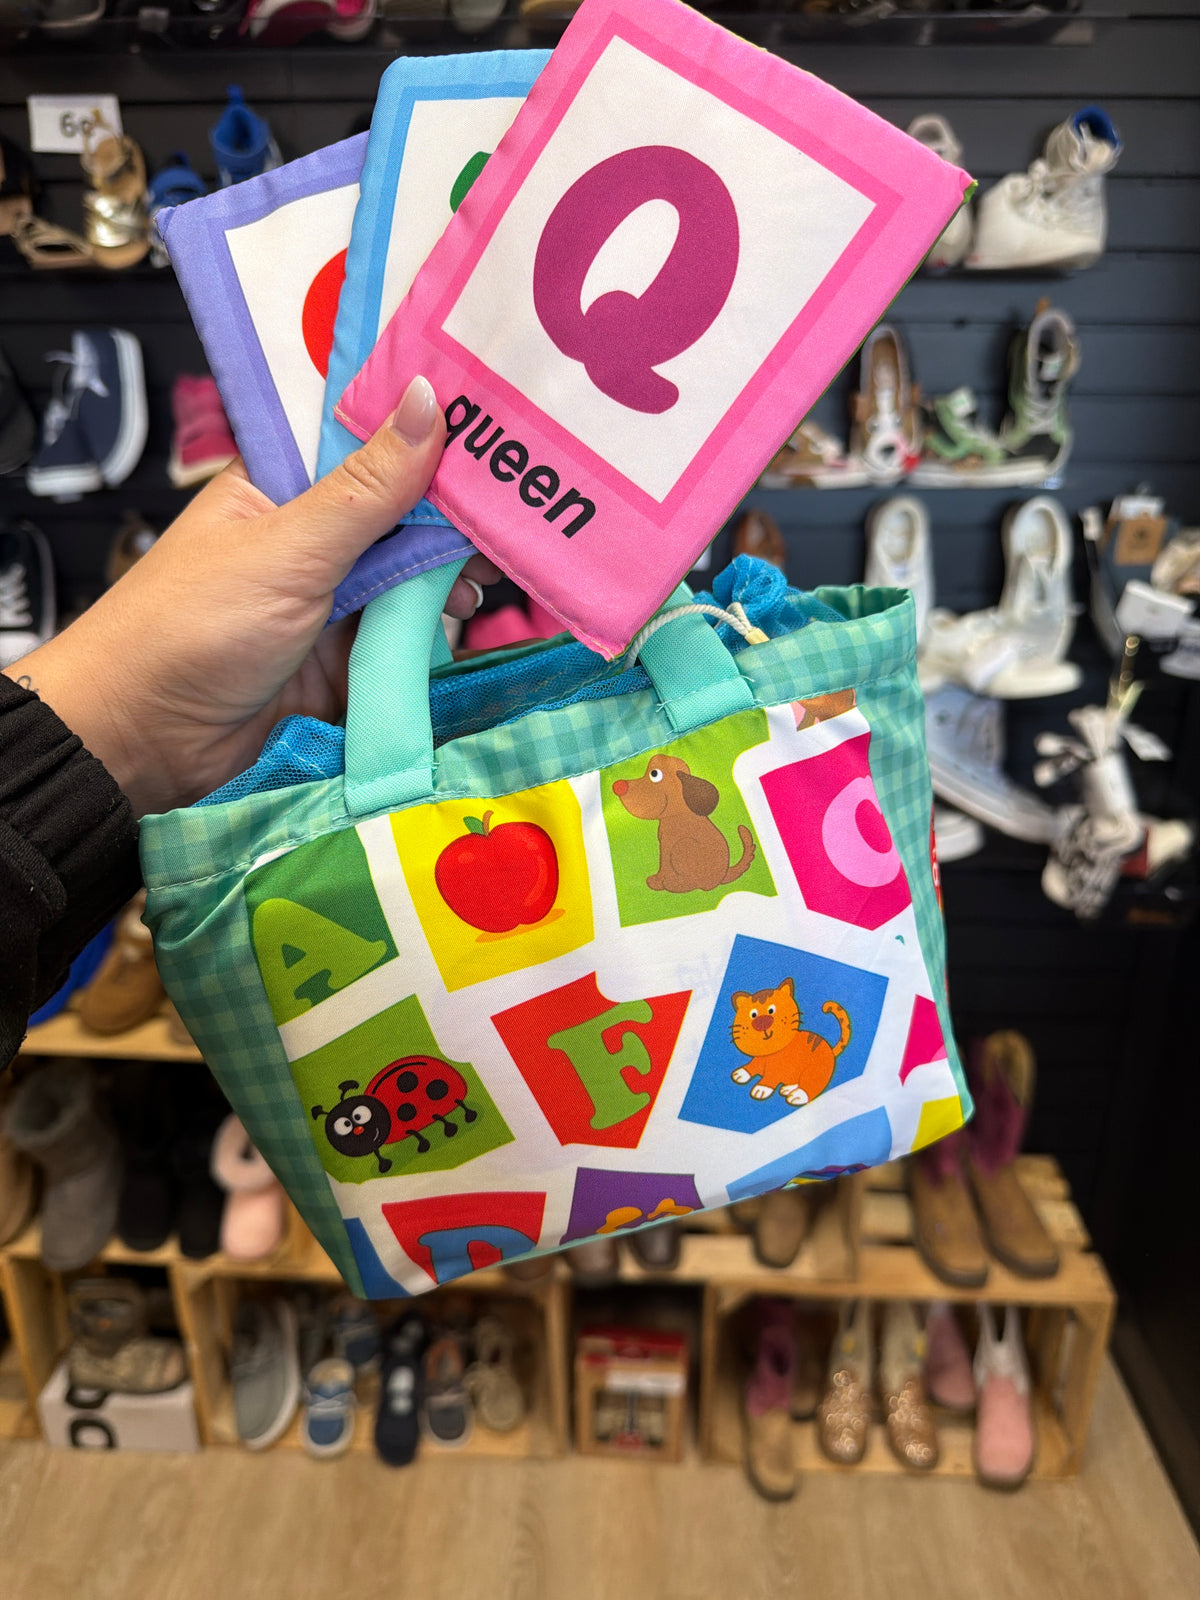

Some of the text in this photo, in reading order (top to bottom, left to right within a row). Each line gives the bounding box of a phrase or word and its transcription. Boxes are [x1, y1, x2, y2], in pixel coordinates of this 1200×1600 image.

[533, 145, 740, 414] Q
[445, 395, 596, 539] queen
[253, 898, 387, 1027] A
